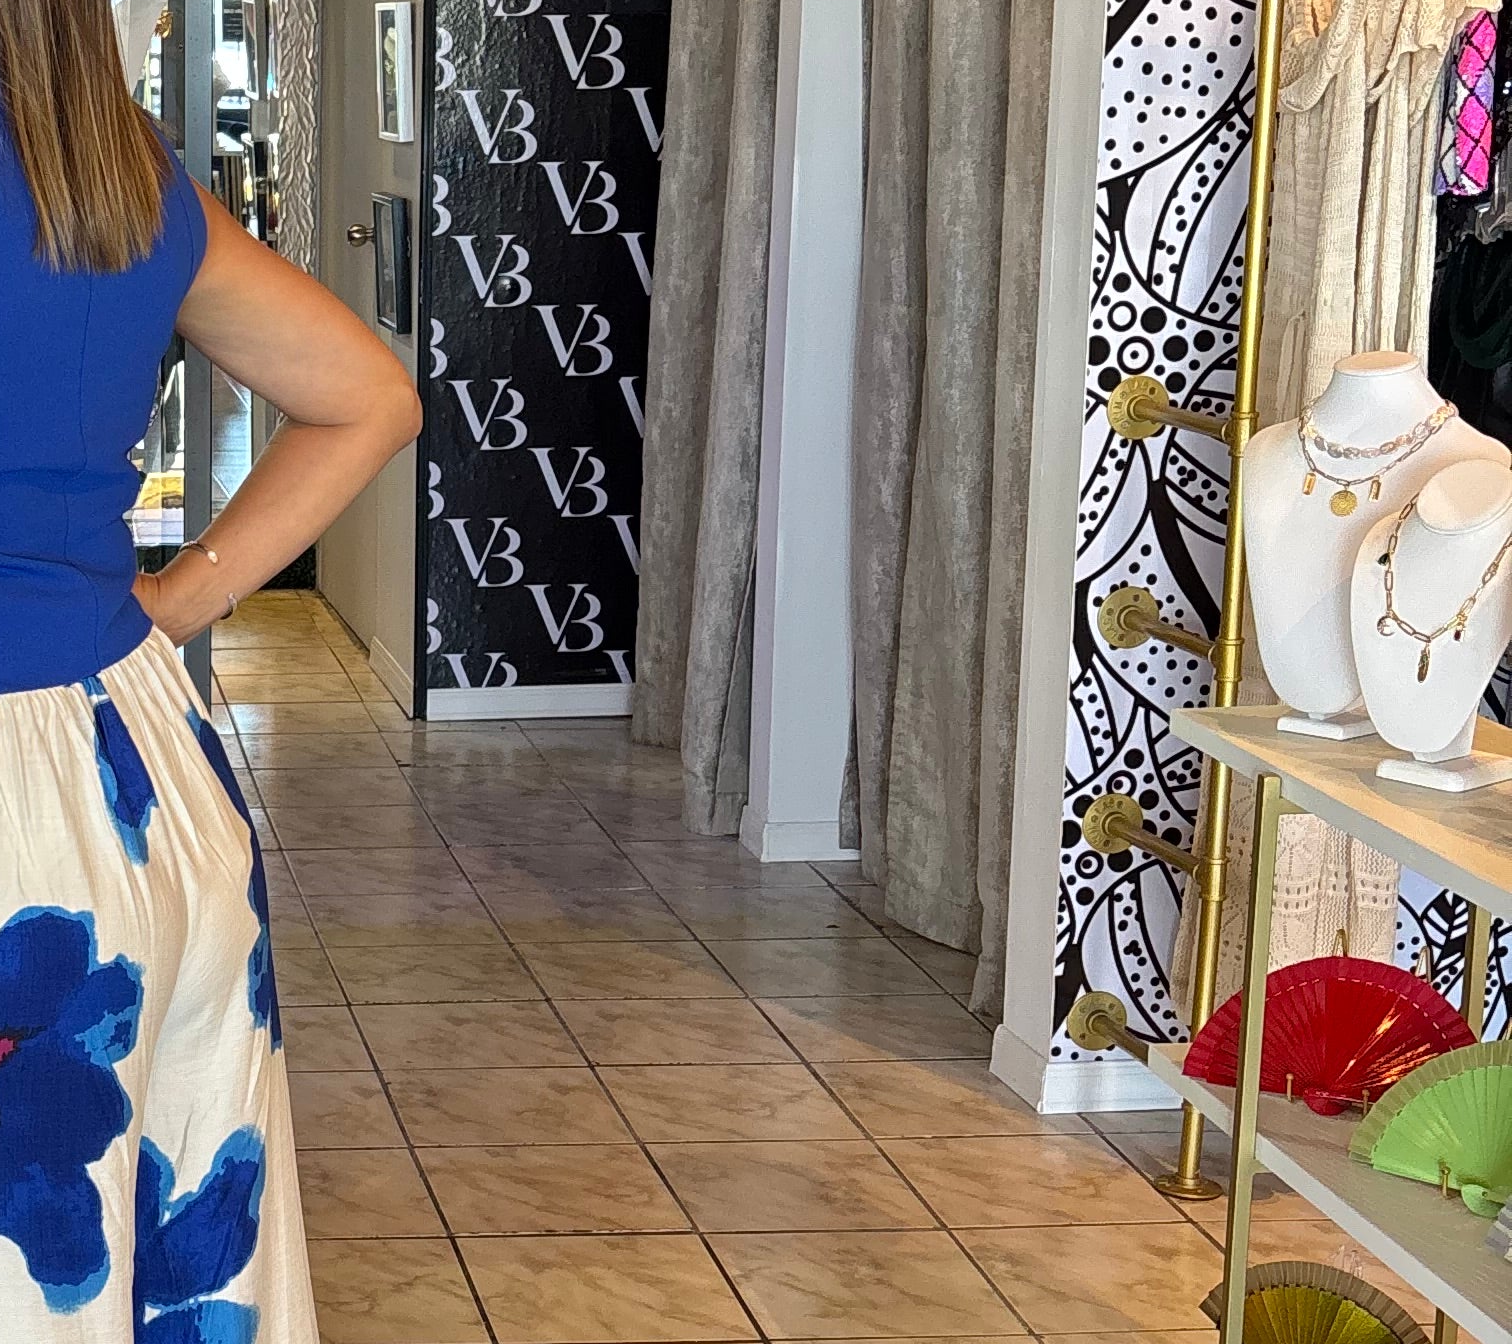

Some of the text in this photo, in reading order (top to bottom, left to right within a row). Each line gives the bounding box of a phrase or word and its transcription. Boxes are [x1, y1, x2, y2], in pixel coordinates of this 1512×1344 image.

[544, 14, 624, 89] VB
[454, 87, 537, 163] VB
[538, 161, 618, 234] VB
[451, 235, 531, 307] VB
[534, 305, 612, 376] VB
[449, 379, 527, 450] VB
[530, 447, 607, 516] VB
[446, 518, 523, 586] VB
[527, 584, 603, 651] VB
